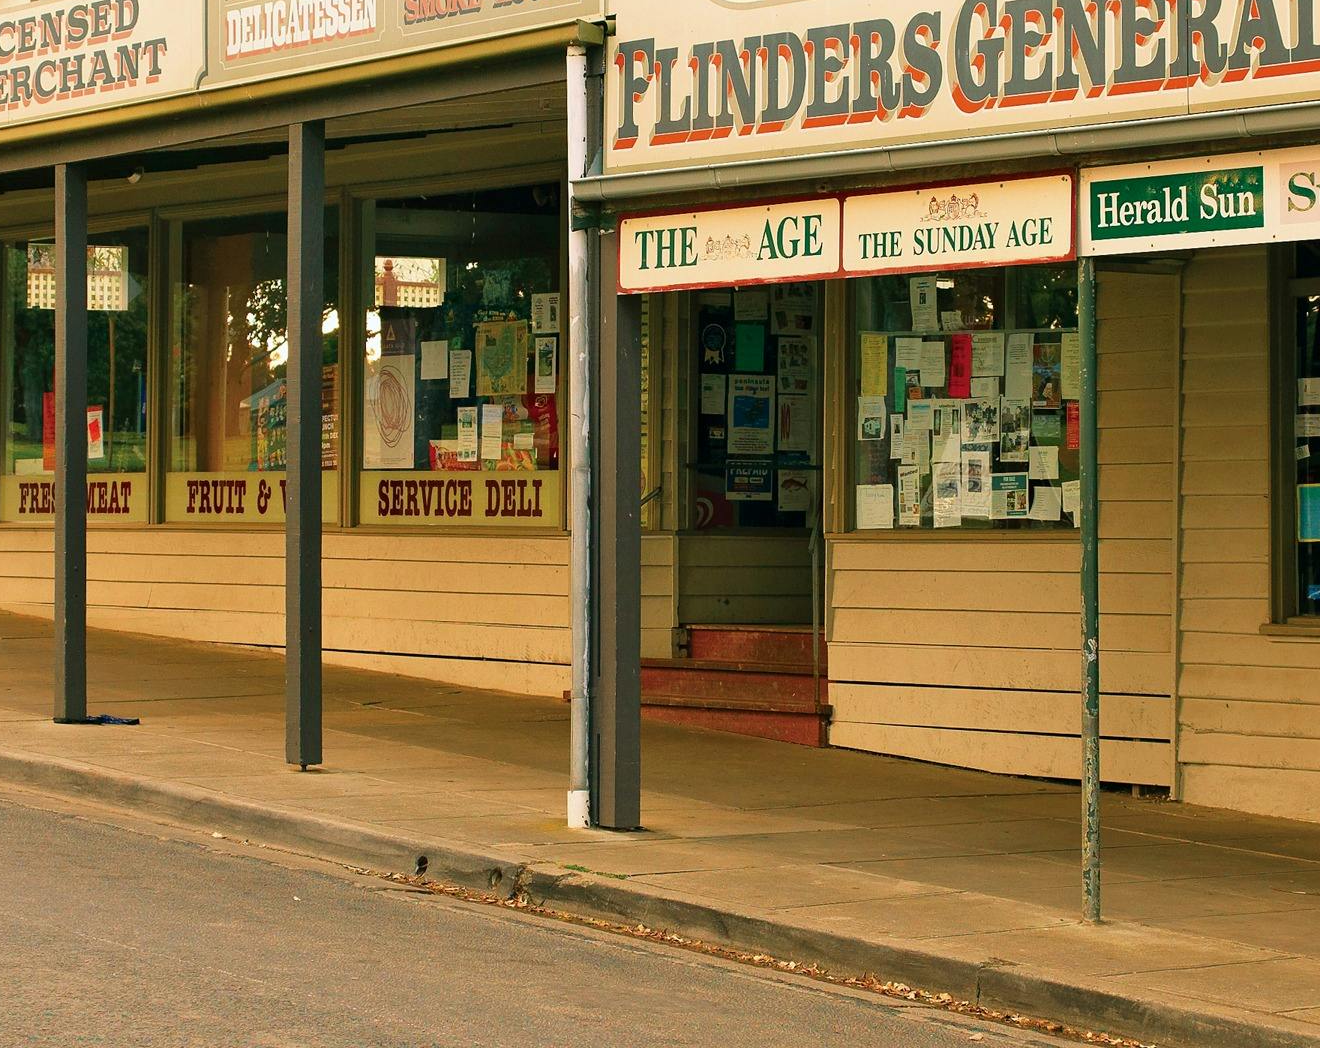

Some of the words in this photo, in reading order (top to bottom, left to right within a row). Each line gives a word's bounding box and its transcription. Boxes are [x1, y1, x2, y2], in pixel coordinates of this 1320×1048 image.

[611, 8, 942, 151] FLINDERS
[1097, 186, 1189, 228] Herald
[1198, 183, 1256, 222] Sun
[635, 226, 699, 271] THE
[756, 214, 823, 262] AGE
[858, 232, 903, 261] THE
[913, 222, 1000, 258] SUNDAY
[1005, 216, 1055, 249] AGE
[19, 482, 56, 514] FRE
[186, 480, 246, 514] FRUIT
[256, 479, 272, 514] &
[377, 479, 473, 517] SERVICE
[484, 479, 543, 517] DELI
